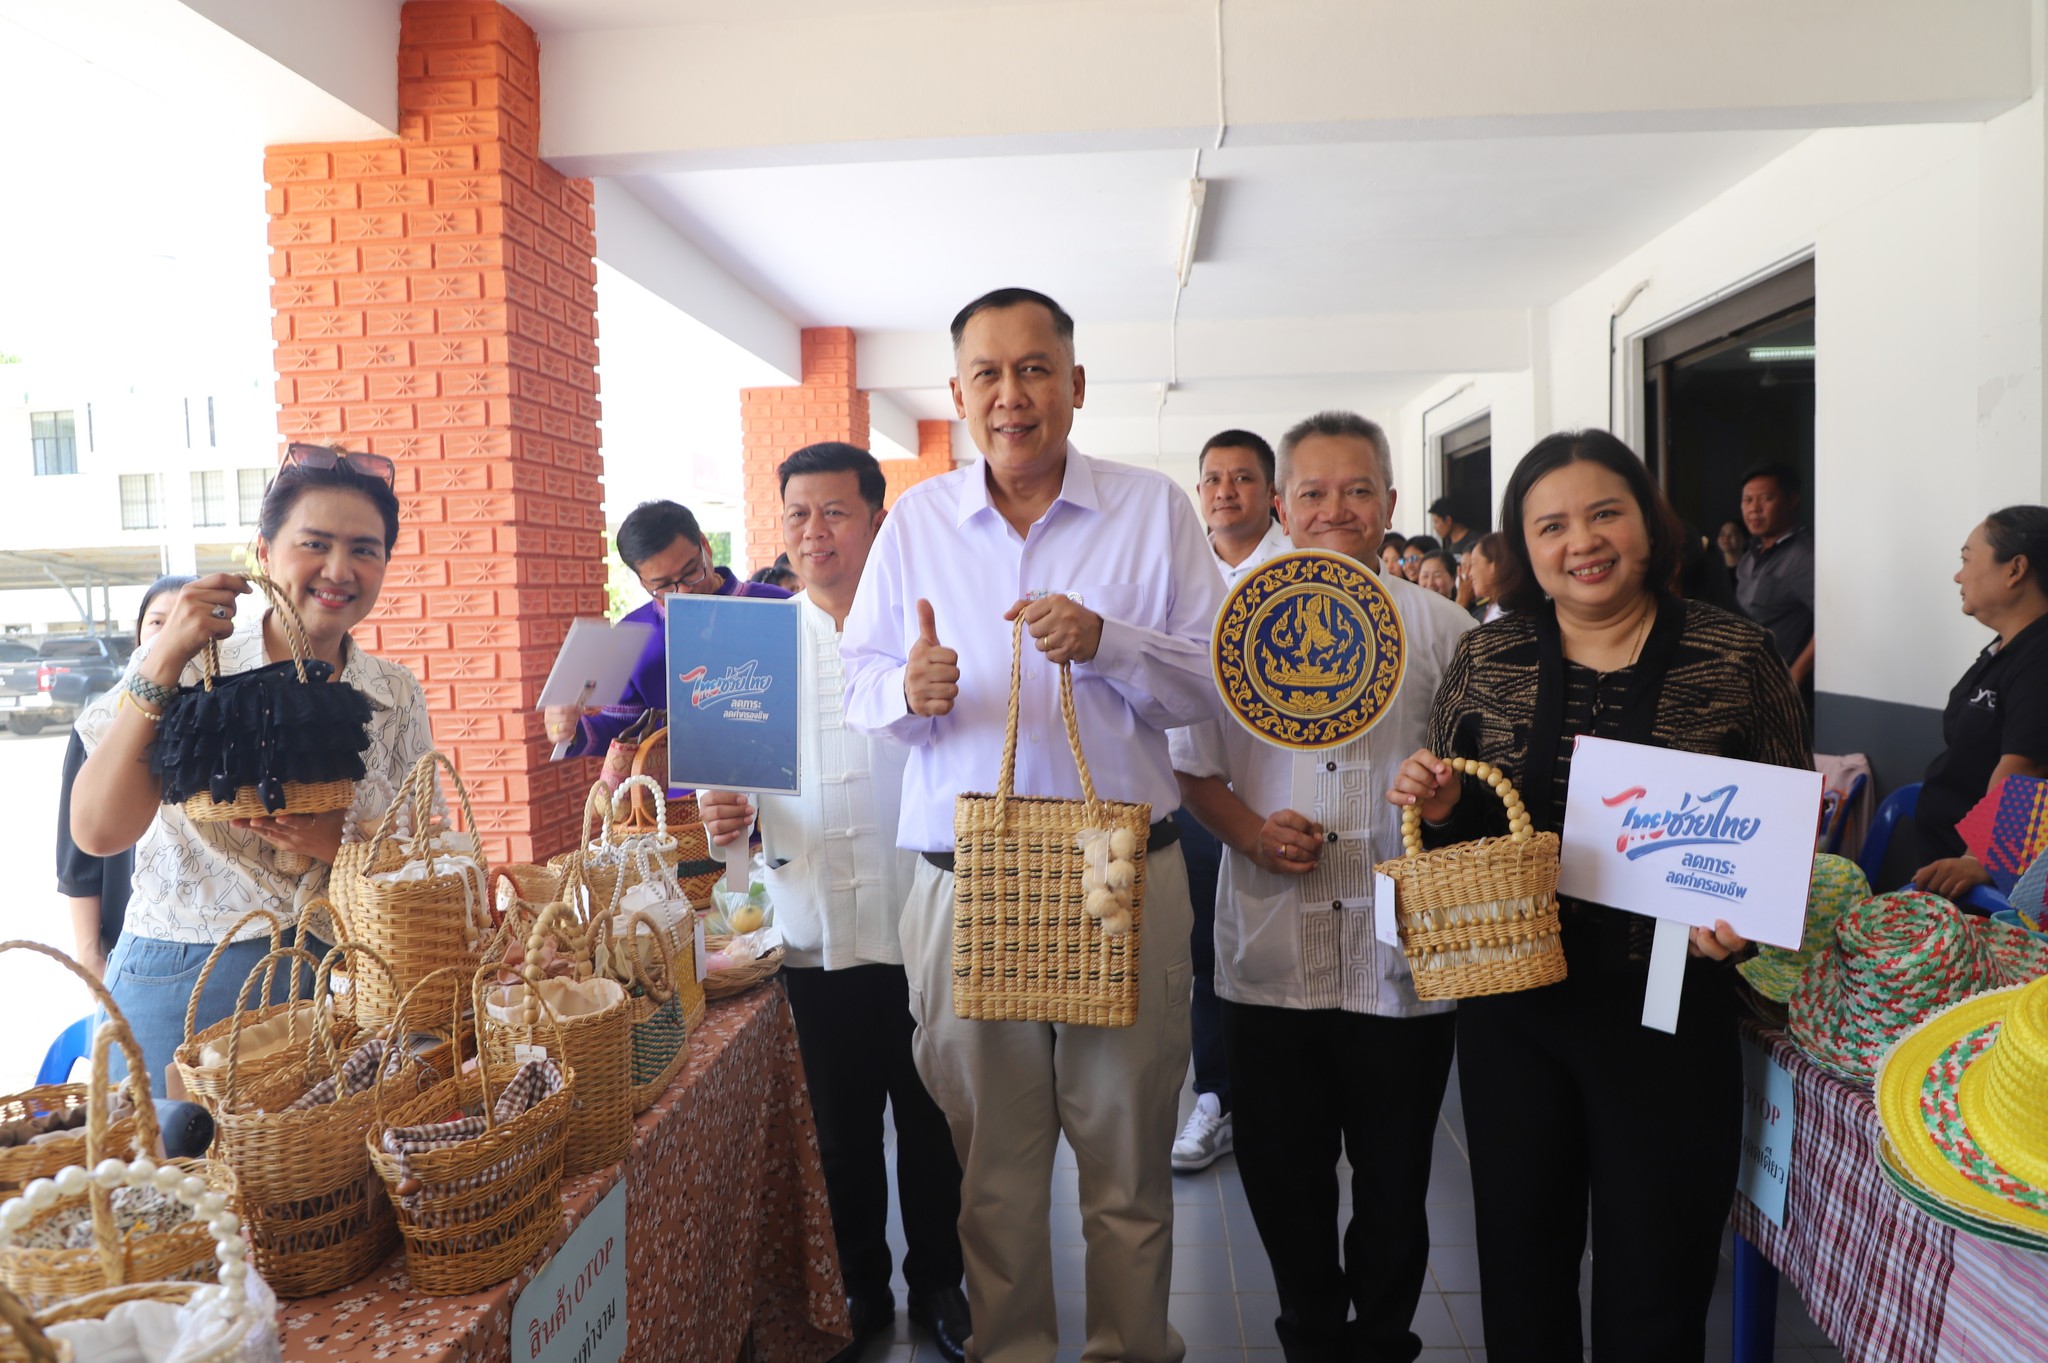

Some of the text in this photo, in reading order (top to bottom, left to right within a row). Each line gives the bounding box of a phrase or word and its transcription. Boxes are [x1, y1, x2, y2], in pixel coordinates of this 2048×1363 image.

[679, 659, 773, 706] ไทยช่วยไทย
[731, 699, 762, 710] ลดภาระ
[1601, 784, 1762, 853] ไทยช่วยไทย
[1681, 851, 1737, 876] ลดภาระ
[1665, 870, 1748, 899] ลดค่าครองชีพ
[528, 1236, 614, 1360] สินค้า OTOP
